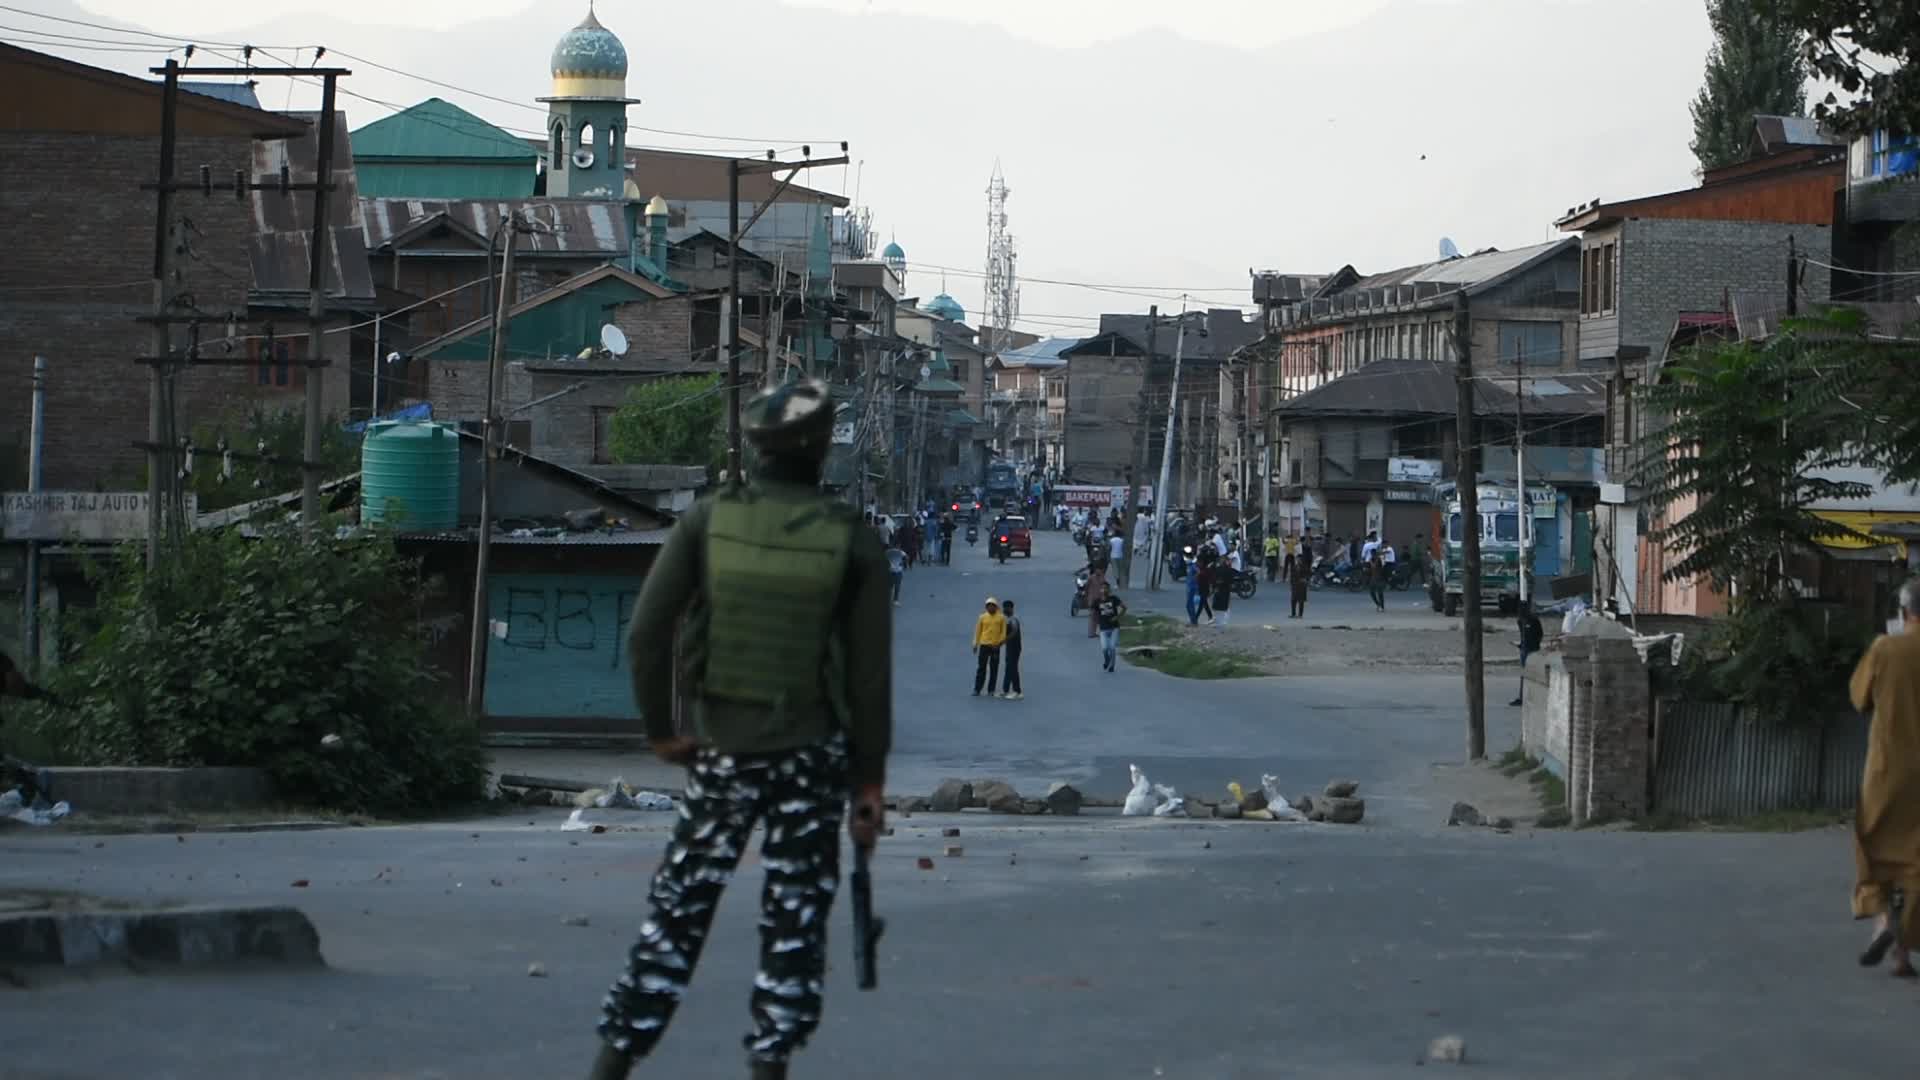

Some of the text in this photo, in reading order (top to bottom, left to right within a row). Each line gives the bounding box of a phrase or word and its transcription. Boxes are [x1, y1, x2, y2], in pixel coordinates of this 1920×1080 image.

[5, 495, 65, 512] KASHMIR
[71, 495, 97, 512] TAJ
[102, 495, 138, 511] AUTO
[1065, 491, 1111, 503] BAKEMAN
